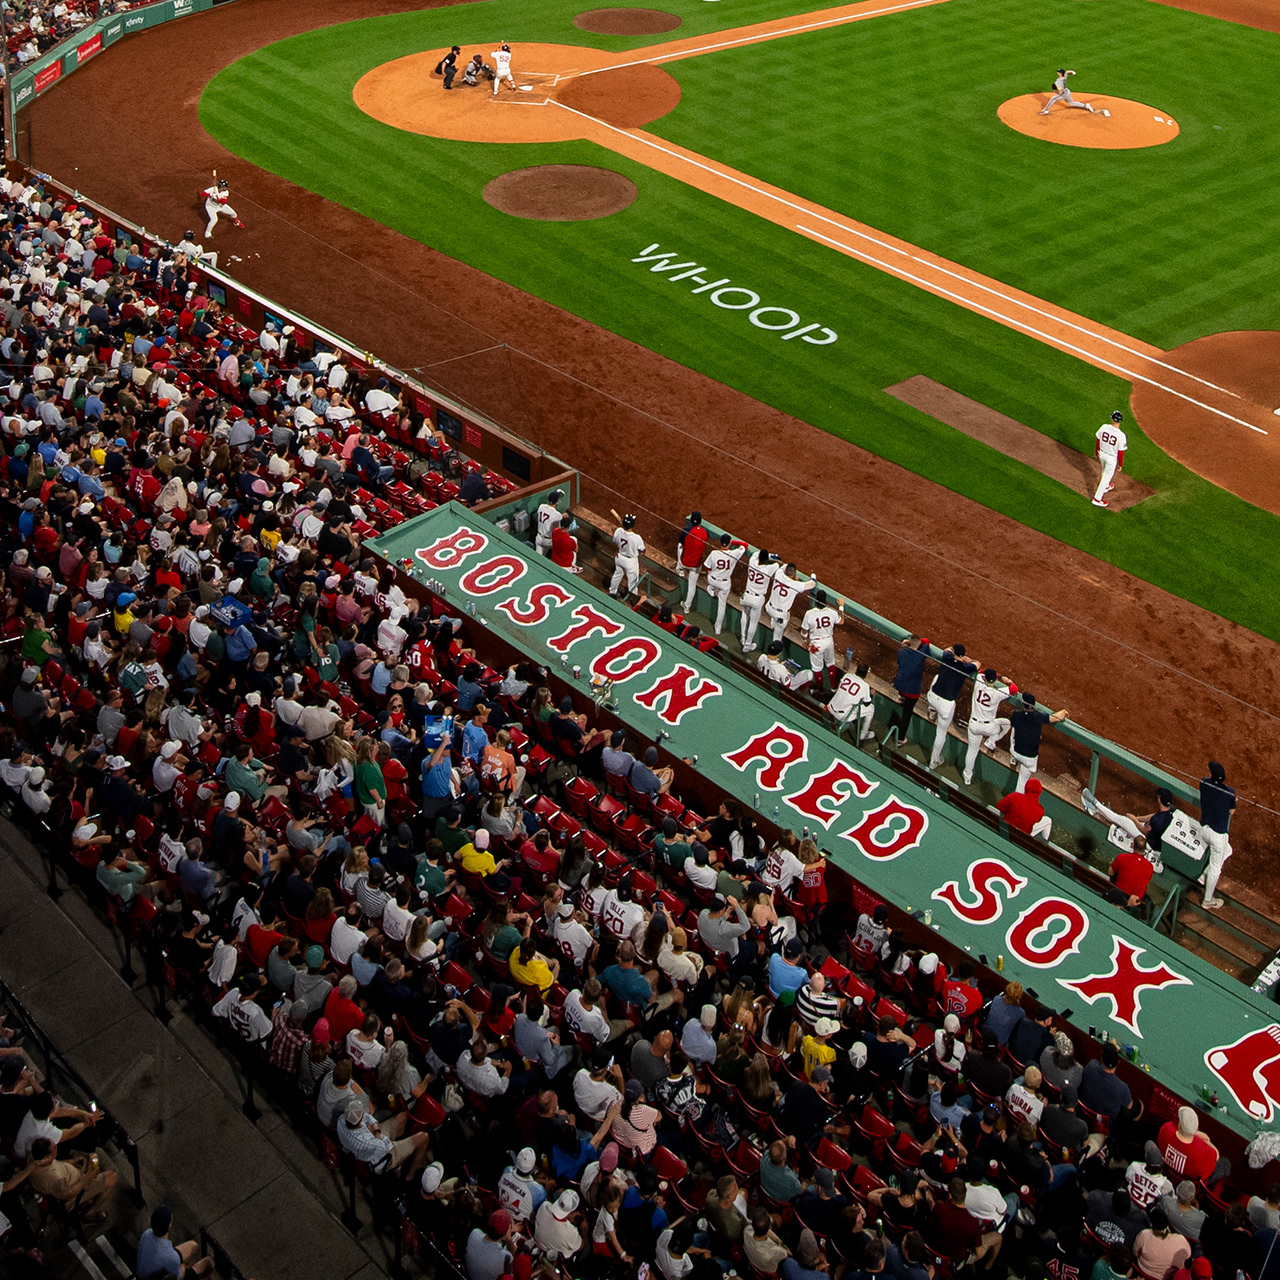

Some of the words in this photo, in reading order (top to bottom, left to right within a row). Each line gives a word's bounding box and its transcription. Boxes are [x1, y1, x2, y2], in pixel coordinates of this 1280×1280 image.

[125, 16, 145, 27] xfinity
[630, 242, 838, 345] WHOOP
[1101, 431, 1117, 447] 83
[538, 511, 550, 524] 17
[619, 538, 627, 549] 7
[715, 558, 731, 570] 91
[748, 571, 764, 585] 32
[814, 615, 831, 629] 16
[838, 678, 861, 697] 20
[413, 524, 723, 728] BOSTON
[720, 720, 929, 863] RED
[929, 856, 1193, 1040] SOX
[1170, 833, 1198, 852] GATORADE
[803, 871, 822, 888] 50
[604, 910, 624, 934] 70
[1010, 1093, 1033, 1116] DURAN
[1134, 1172, 1158, 1193] BETTS
